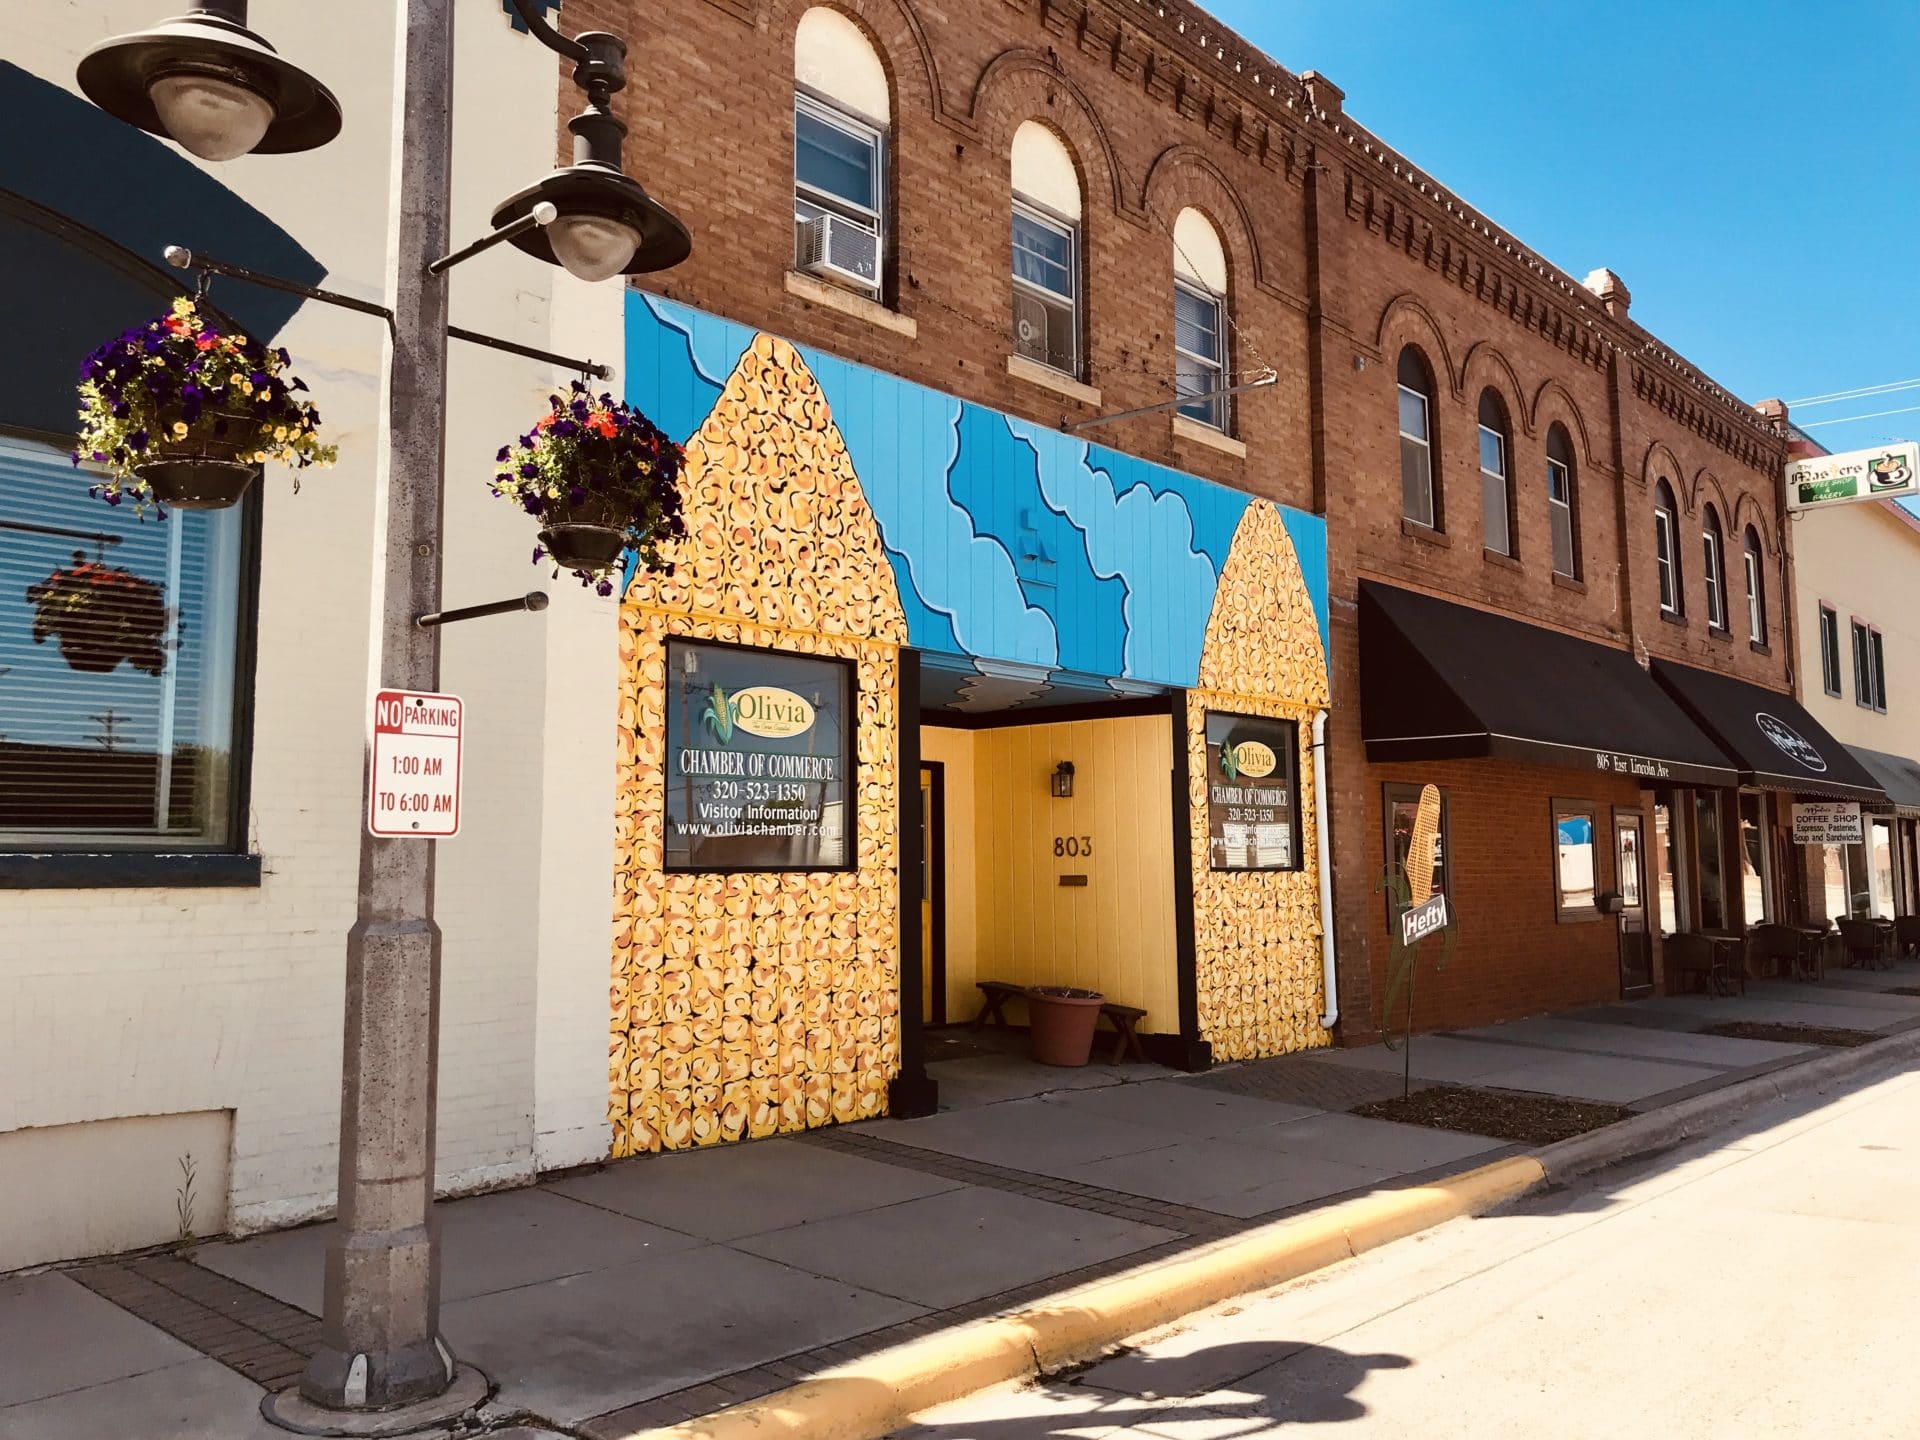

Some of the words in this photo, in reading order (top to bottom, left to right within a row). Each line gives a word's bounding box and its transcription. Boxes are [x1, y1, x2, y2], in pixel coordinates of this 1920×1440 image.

[1790, 464, 1863, 485] Masers
[1812, 490, 1844, 501] BAKERY
[377, 700, 401, 727] NO
[404, 706, 457, 727] PARKING
[737, 693, 806, 723] Olivia
[392, 756, 419, 775] 1:00
[424, 757, 442, 775] AM
[681, 749, 744, 776] CHAMBER
[750, 753, 765, 777] OF
[769, 755, 834, 780] COMMERCE
[1237, 746, 1272, 767] Olivia
[1596, 753, 1610, 770] 805
[1614, 756, 1627, 772] East
[1630, 758, 1656, 776] Lincoln
[1657, 762, 1669, 777] Ave
[713, 781, 806, 801] 320-523-1350
[1212, 786, 1243, 804] CHAMBER
[1244, 788, 1253, 805] OF
[1254, 789, 1288, 806] COMMERCE
[380, 792, 395, 811] TO
[400, 793, 429, 812] 6:00
[433, 794, 451, 812] AM
[700, 803, 742, 819] Visitor
[747, 804, 818, 821] Information
[1228, 808, 1274, 822] 320-523-1350
[1796, 815, 1829, 823] COFFEE
[678, 822, 836, 837] www.oliviachamber.com
[1793, 834, 1809, 843] Soup
[1826, 833, 1862, 841] Sandwiches
[1054, 836, 1092, 857] 803
[1407, 904, 1443, 936] Hefty
